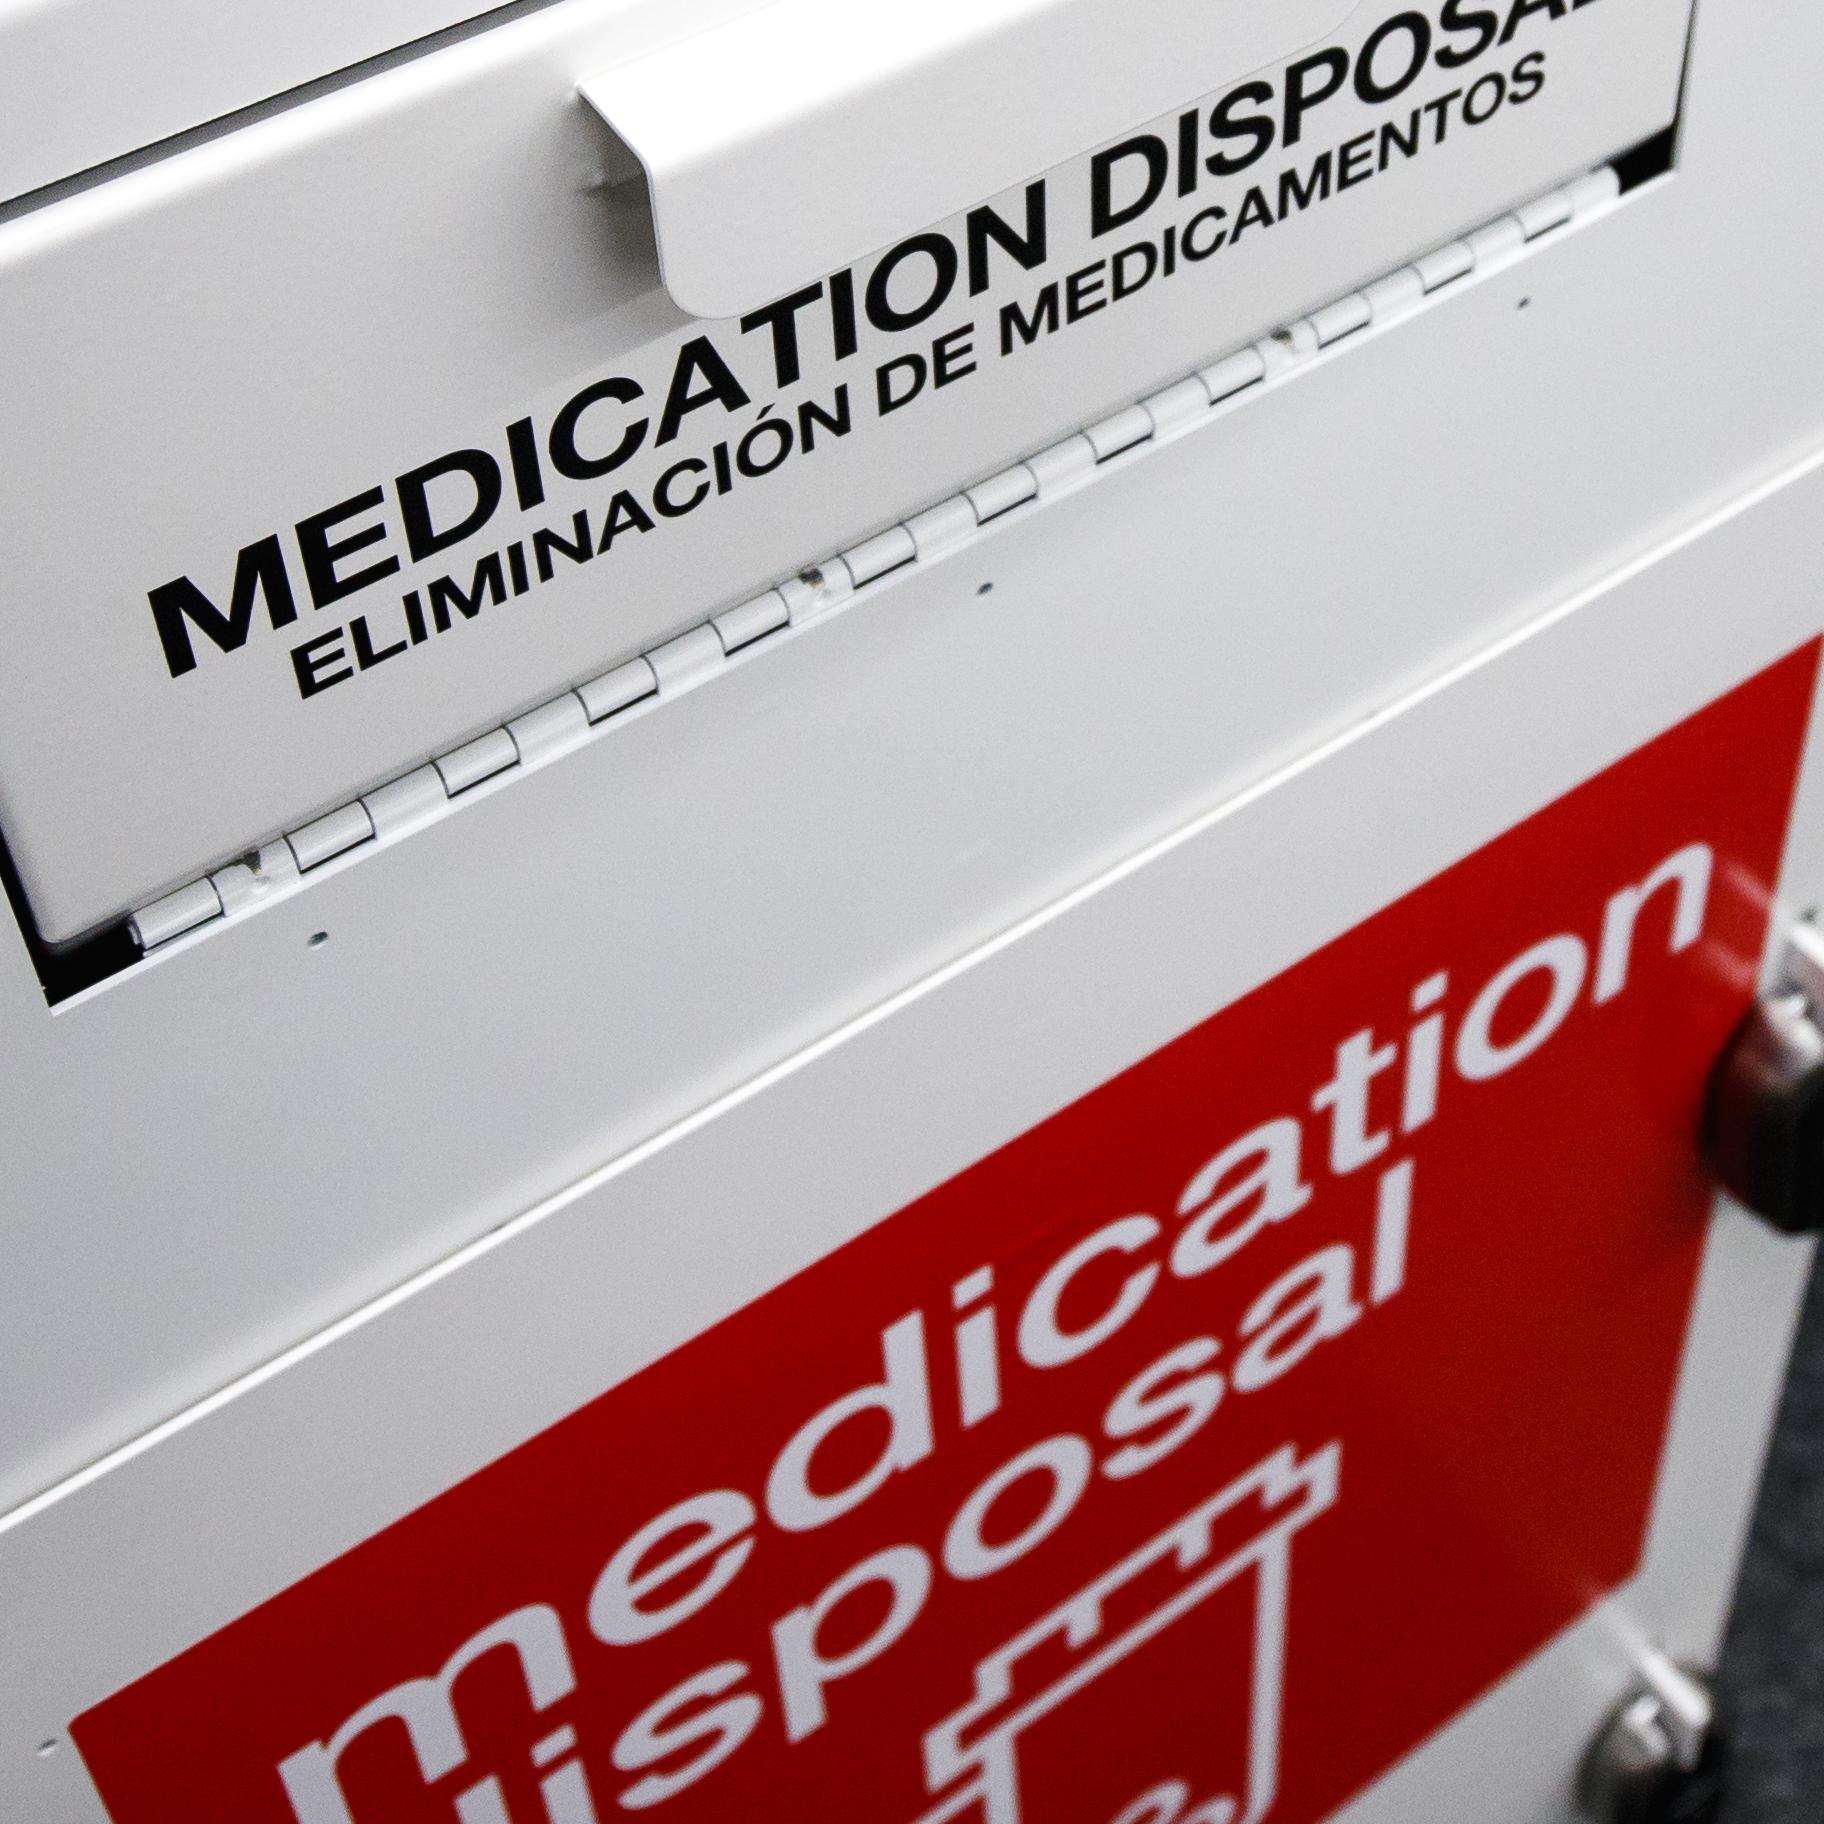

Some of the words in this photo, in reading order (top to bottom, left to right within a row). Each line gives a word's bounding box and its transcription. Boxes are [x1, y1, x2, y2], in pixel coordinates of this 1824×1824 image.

[148, 180, 1046, 676] MEDICATION
[291, 384, 850, 698] ELIMINACIÓN
[877, 323, 976, 410] DE
[1000, 53, 1543, 353] MEDICAMENTOS
[279, 843, 1711, 1824] medication
[452, 1160, 1416, 1824] isposal
